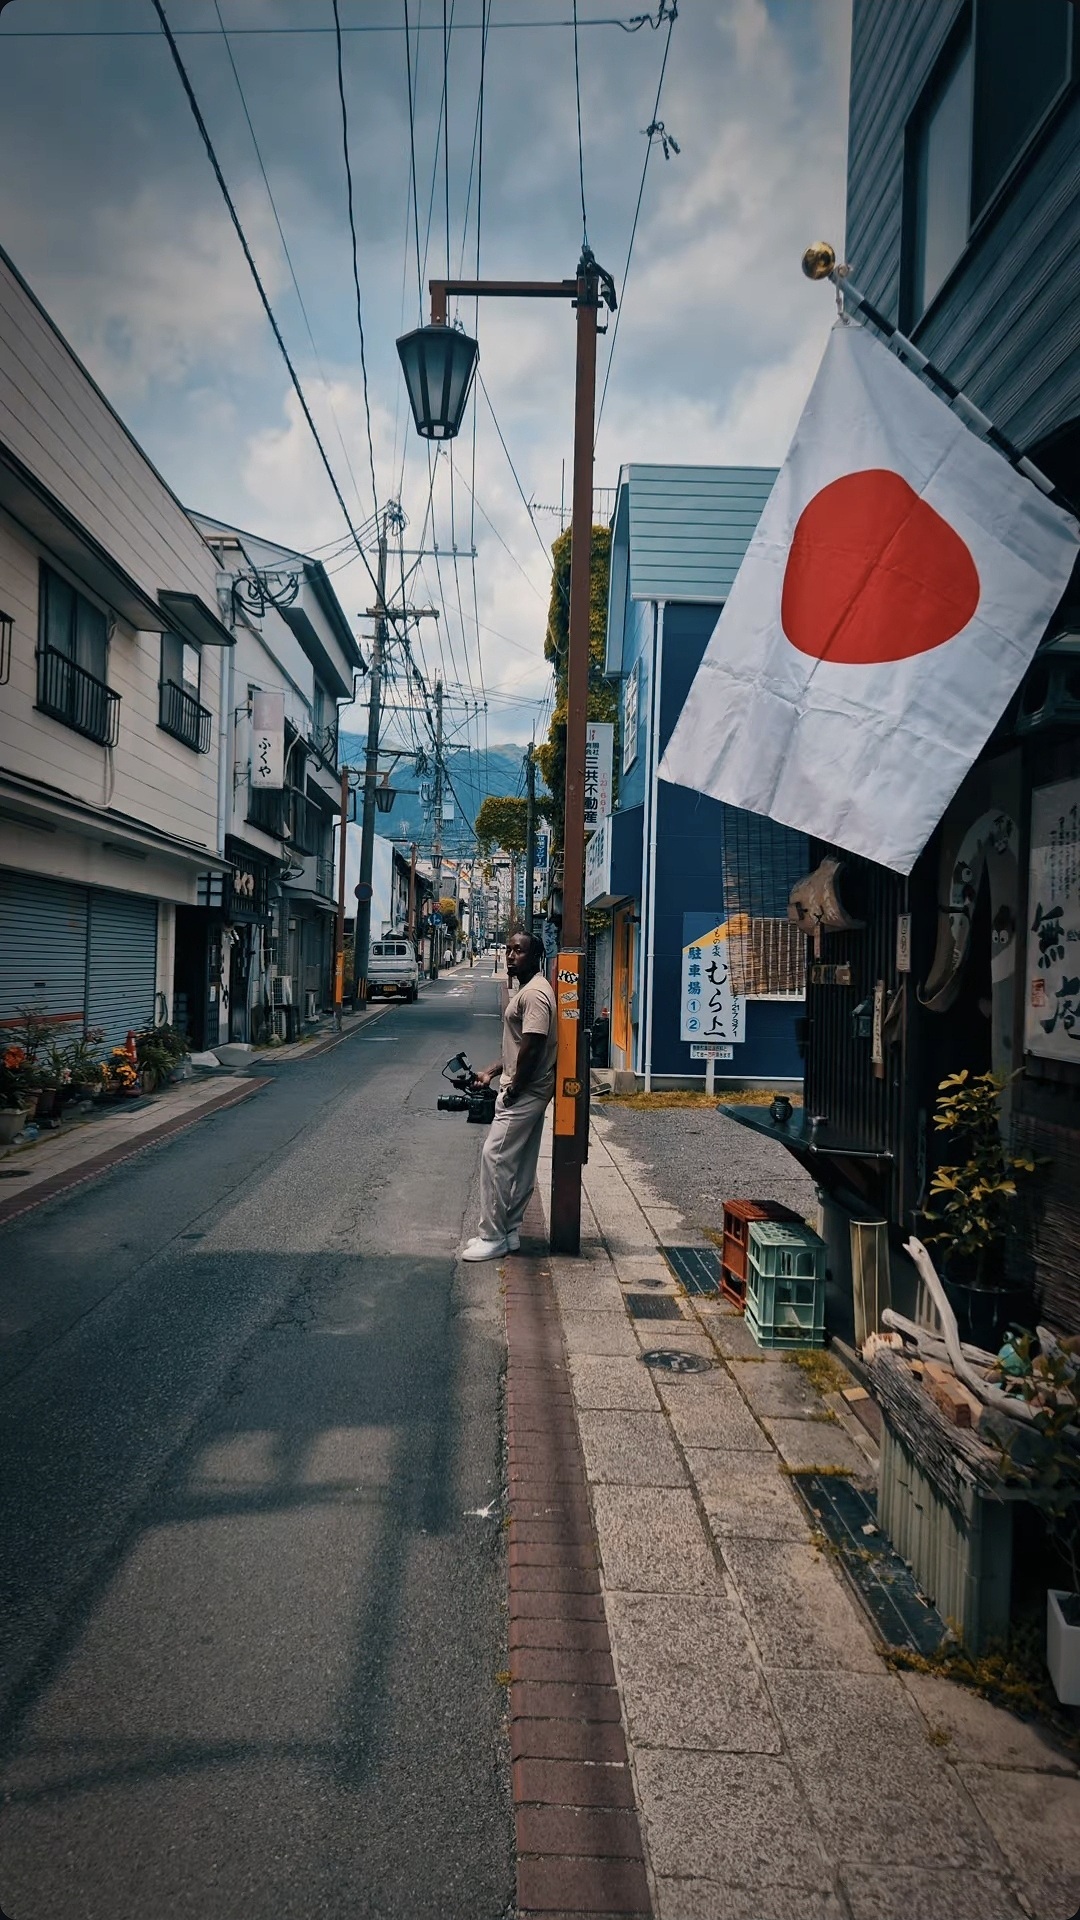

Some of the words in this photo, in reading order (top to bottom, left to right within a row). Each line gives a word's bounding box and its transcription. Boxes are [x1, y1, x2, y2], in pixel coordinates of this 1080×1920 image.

[258, 737, 272, 778] ふくや
[584, 757, 599, 823] 三共不動産
[703, 960, 729, 1038] むら上
